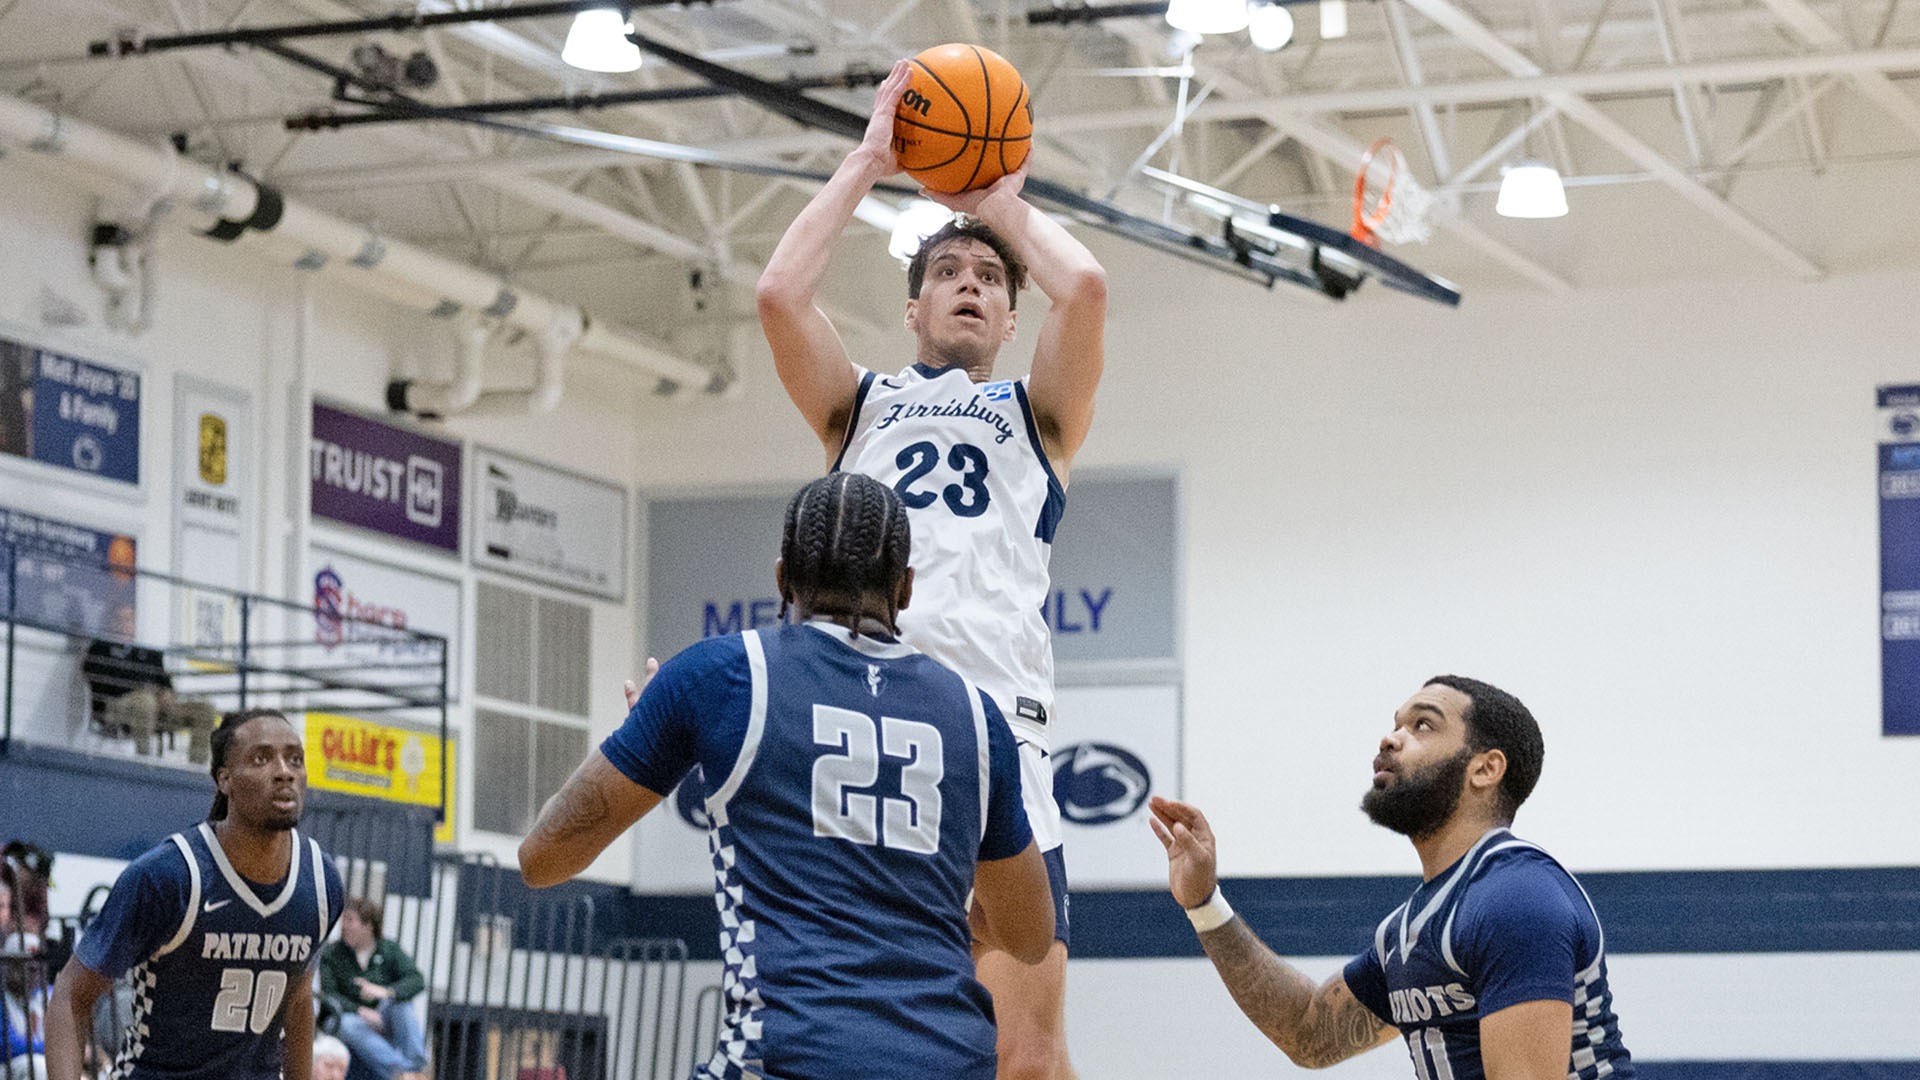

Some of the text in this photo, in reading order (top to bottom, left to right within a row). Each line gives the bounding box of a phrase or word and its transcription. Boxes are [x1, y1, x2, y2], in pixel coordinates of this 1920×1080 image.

[312, 438, 405, 503] TRUIST
[894, 441, 990, 517] 23
[811, 703, 944, 855] 23
[201, 932, 312, 962] PATRIOTS
[211, 968, 288, 1034] 20
